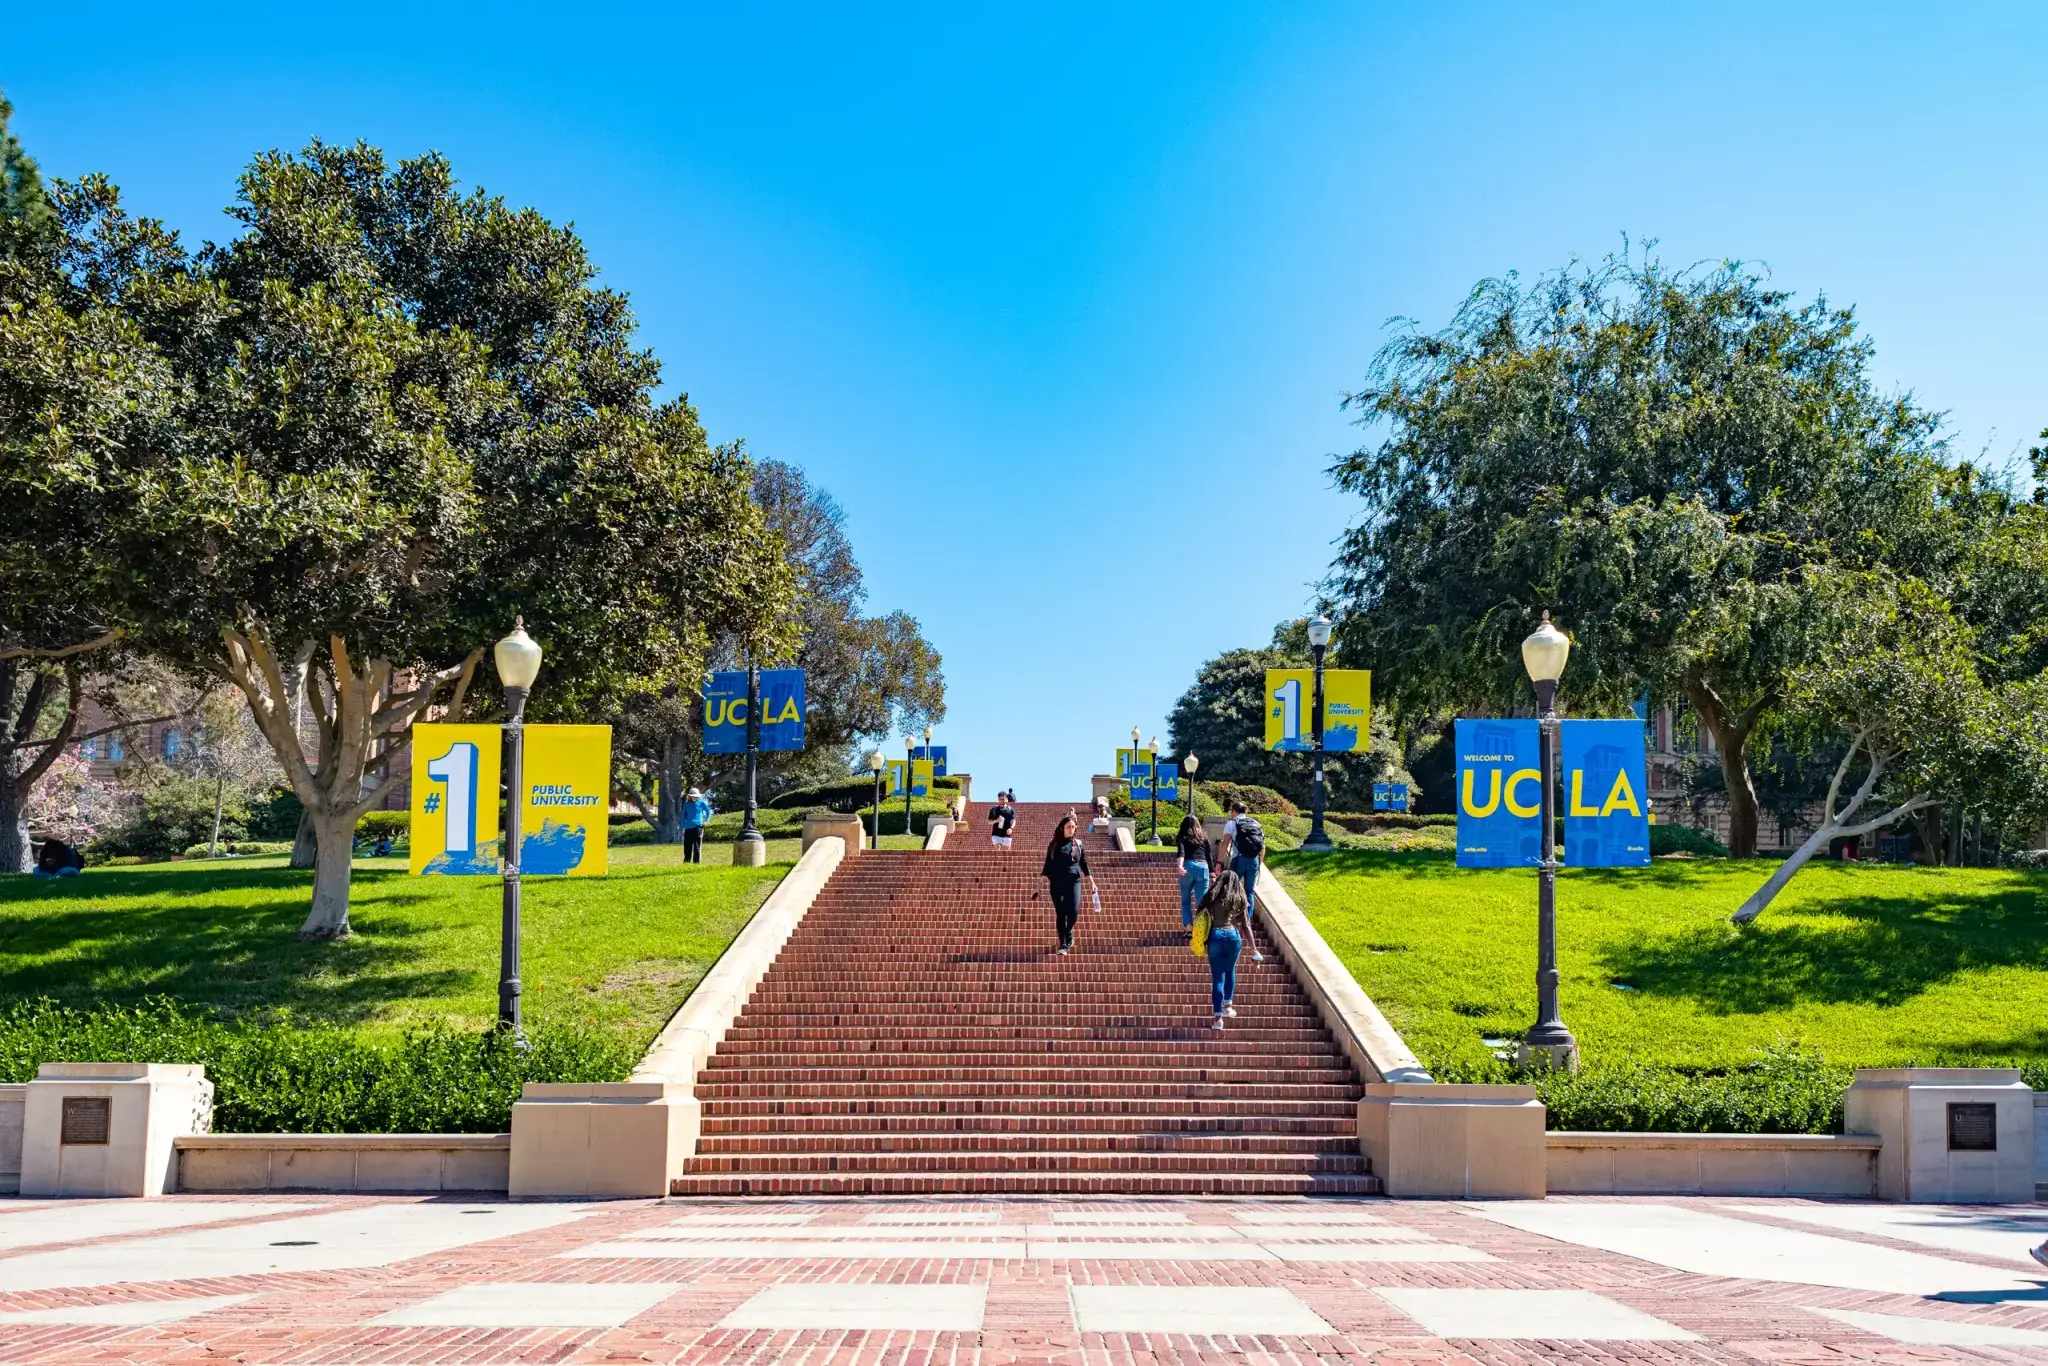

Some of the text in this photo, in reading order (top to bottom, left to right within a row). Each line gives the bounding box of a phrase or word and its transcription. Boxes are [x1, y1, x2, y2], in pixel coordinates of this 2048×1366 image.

[531, 785, 573, 795] PUBLIC
[423, 742, 480, 857] #1
[530, 795, 600, 806] UNIVERSITY
